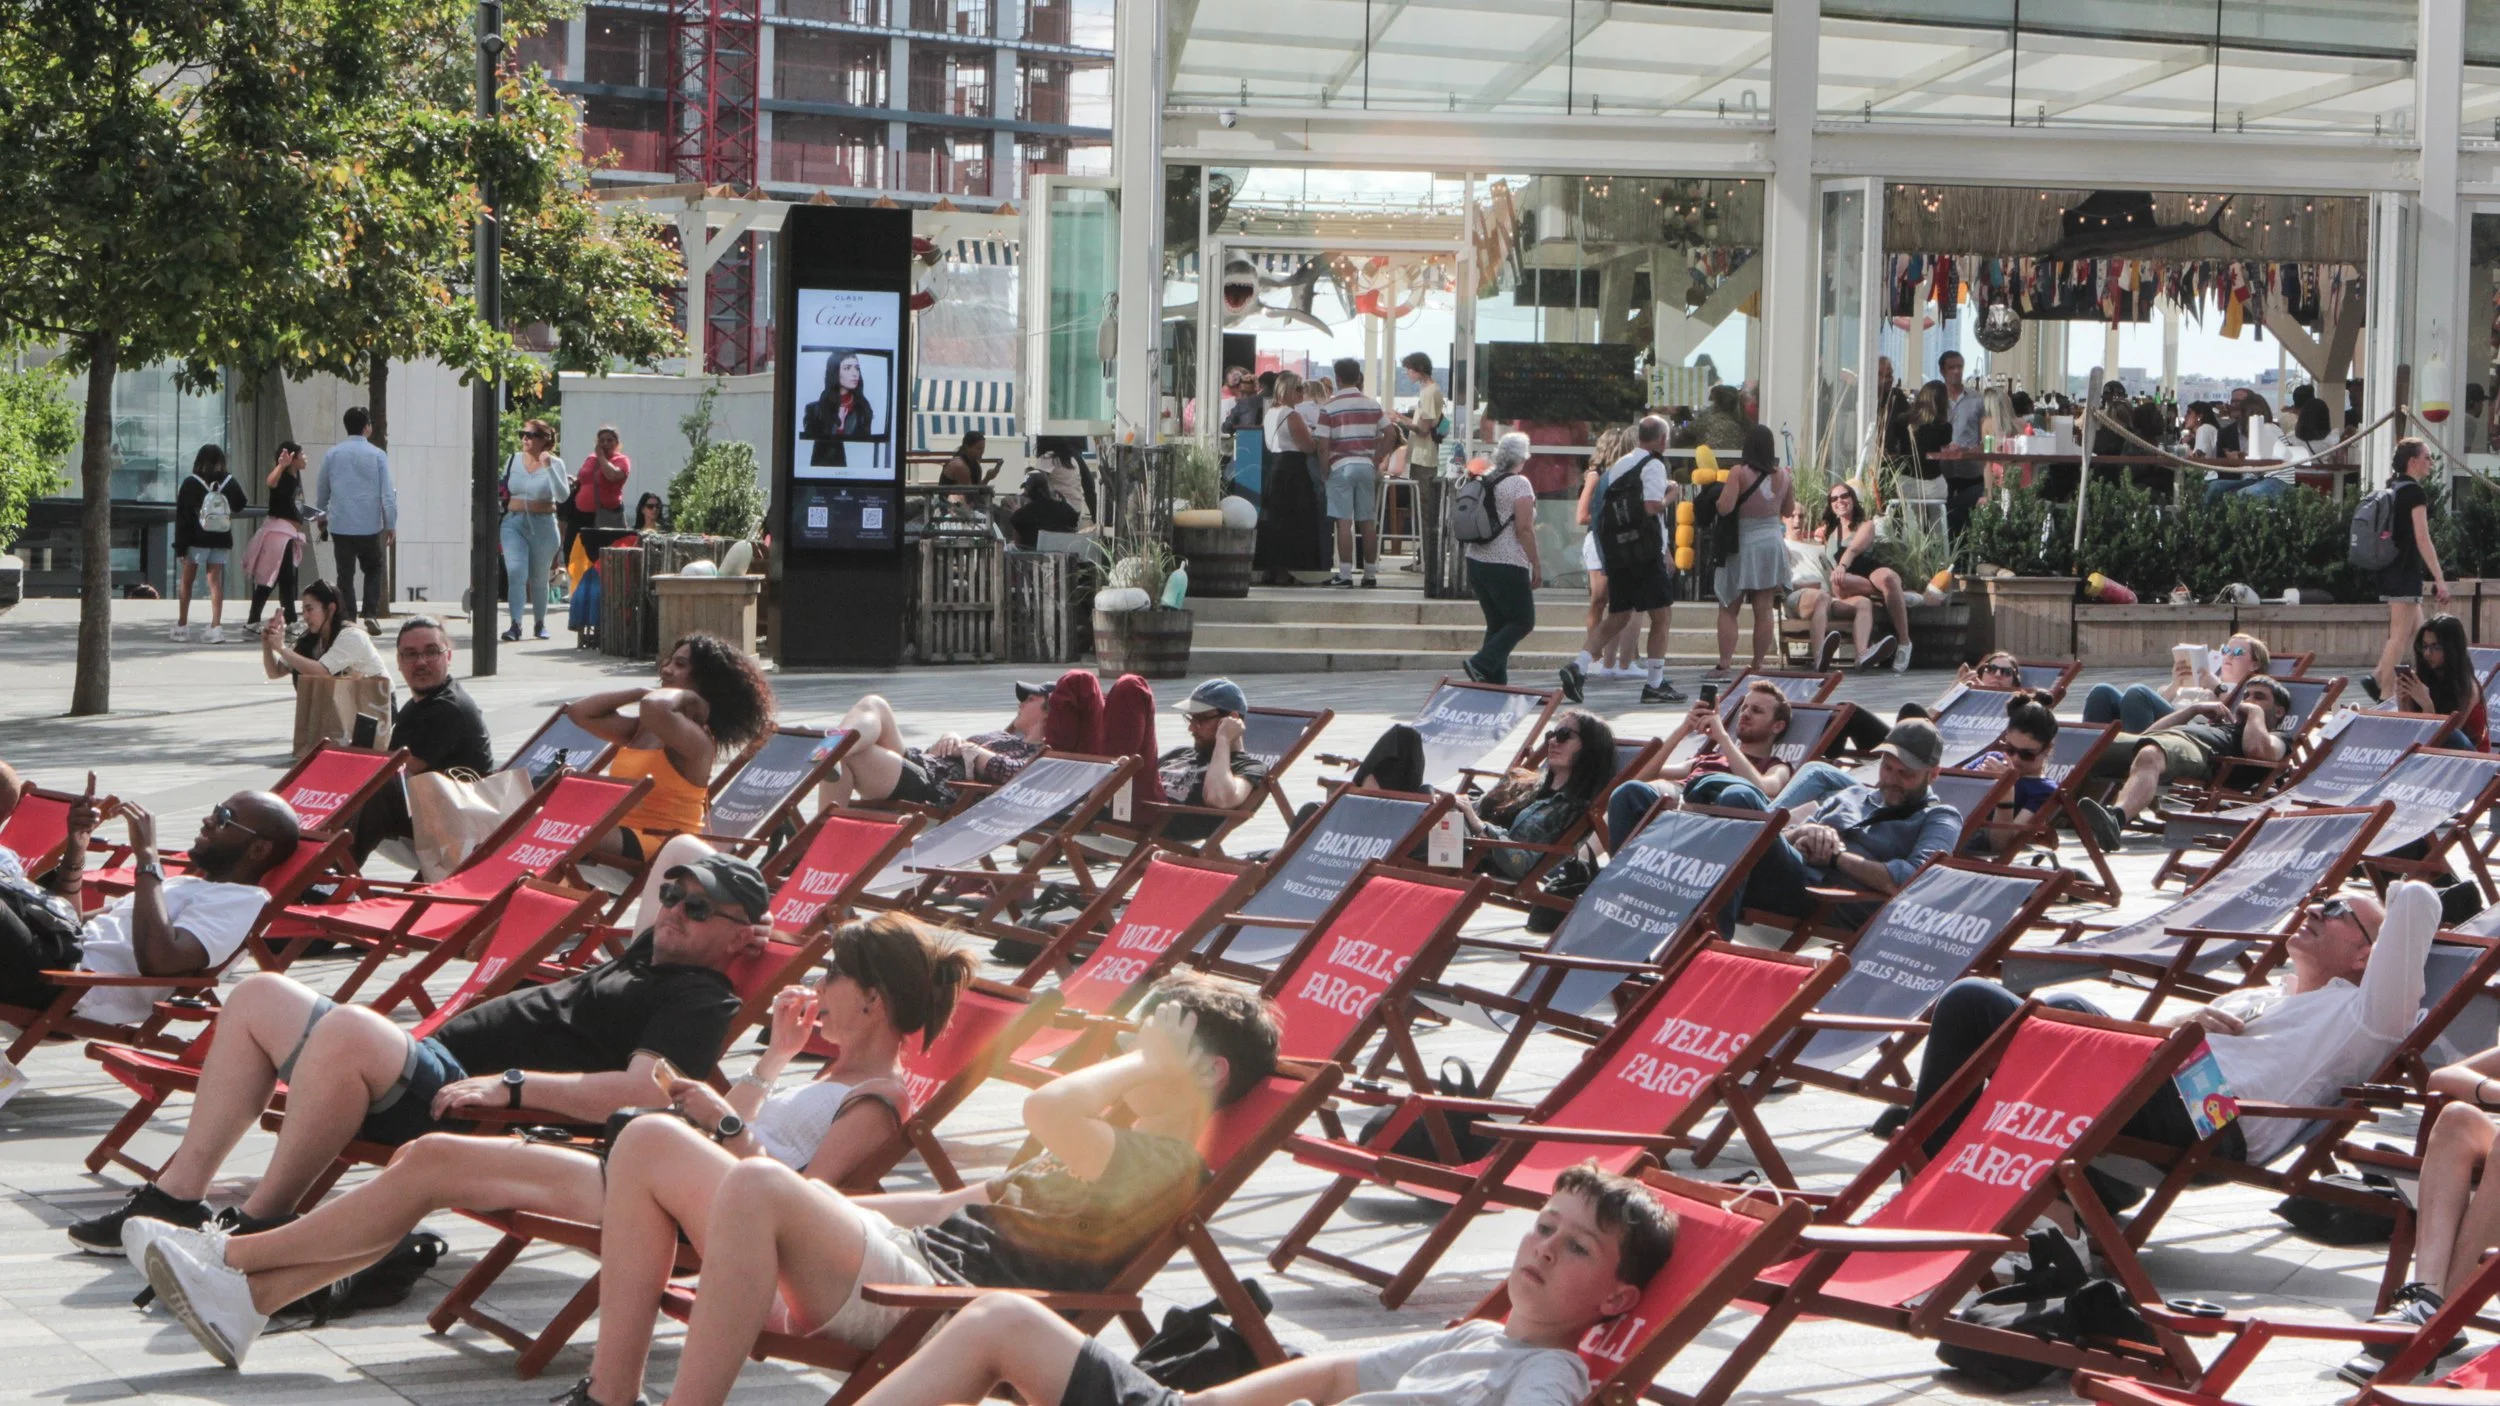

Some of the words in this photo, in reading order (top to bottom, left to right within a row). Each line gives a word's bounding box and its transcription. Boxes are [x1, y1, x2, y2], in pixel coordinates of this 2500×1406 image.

[815, 306, 882, 327] Cartier
[1435, 707, 1514, 726] BACKYARD
[1942, 714, 2011, 730] BACKYARD
[2337, 746, 2404, 765] BACKYAR
[290, 787, 350, 809] WELLS
[2380, 782, 2462, 809] BACKYARD
[1314, 830, 1392, 860] BACKYARD
[1626, 845, 1727, 888] BACKYARD
[1283, 880, 1319, 898] WELLS
[1630, 869, 1675, 893] HUDSON
[1594, 898, 1642, 928] WELLS
[1617, 892, 1666, 916] PRESENTED
[1888, 900, 1992, 944] BACKYARD
[1880, 927, 1891, 937] AT
[1890, 927, 1935, 947] HUDSON
[1934, 938, 1974, 958] YARDS
[1877, 949, 1920, 968] PRESENTED
[1922, 963, 1937, 973] BY
[1892, 969, 1945, 992] FARGO
[1651, 1017, 1750, 1064] WELLS
[1982, 1100, 2094, 1150] WELLS
